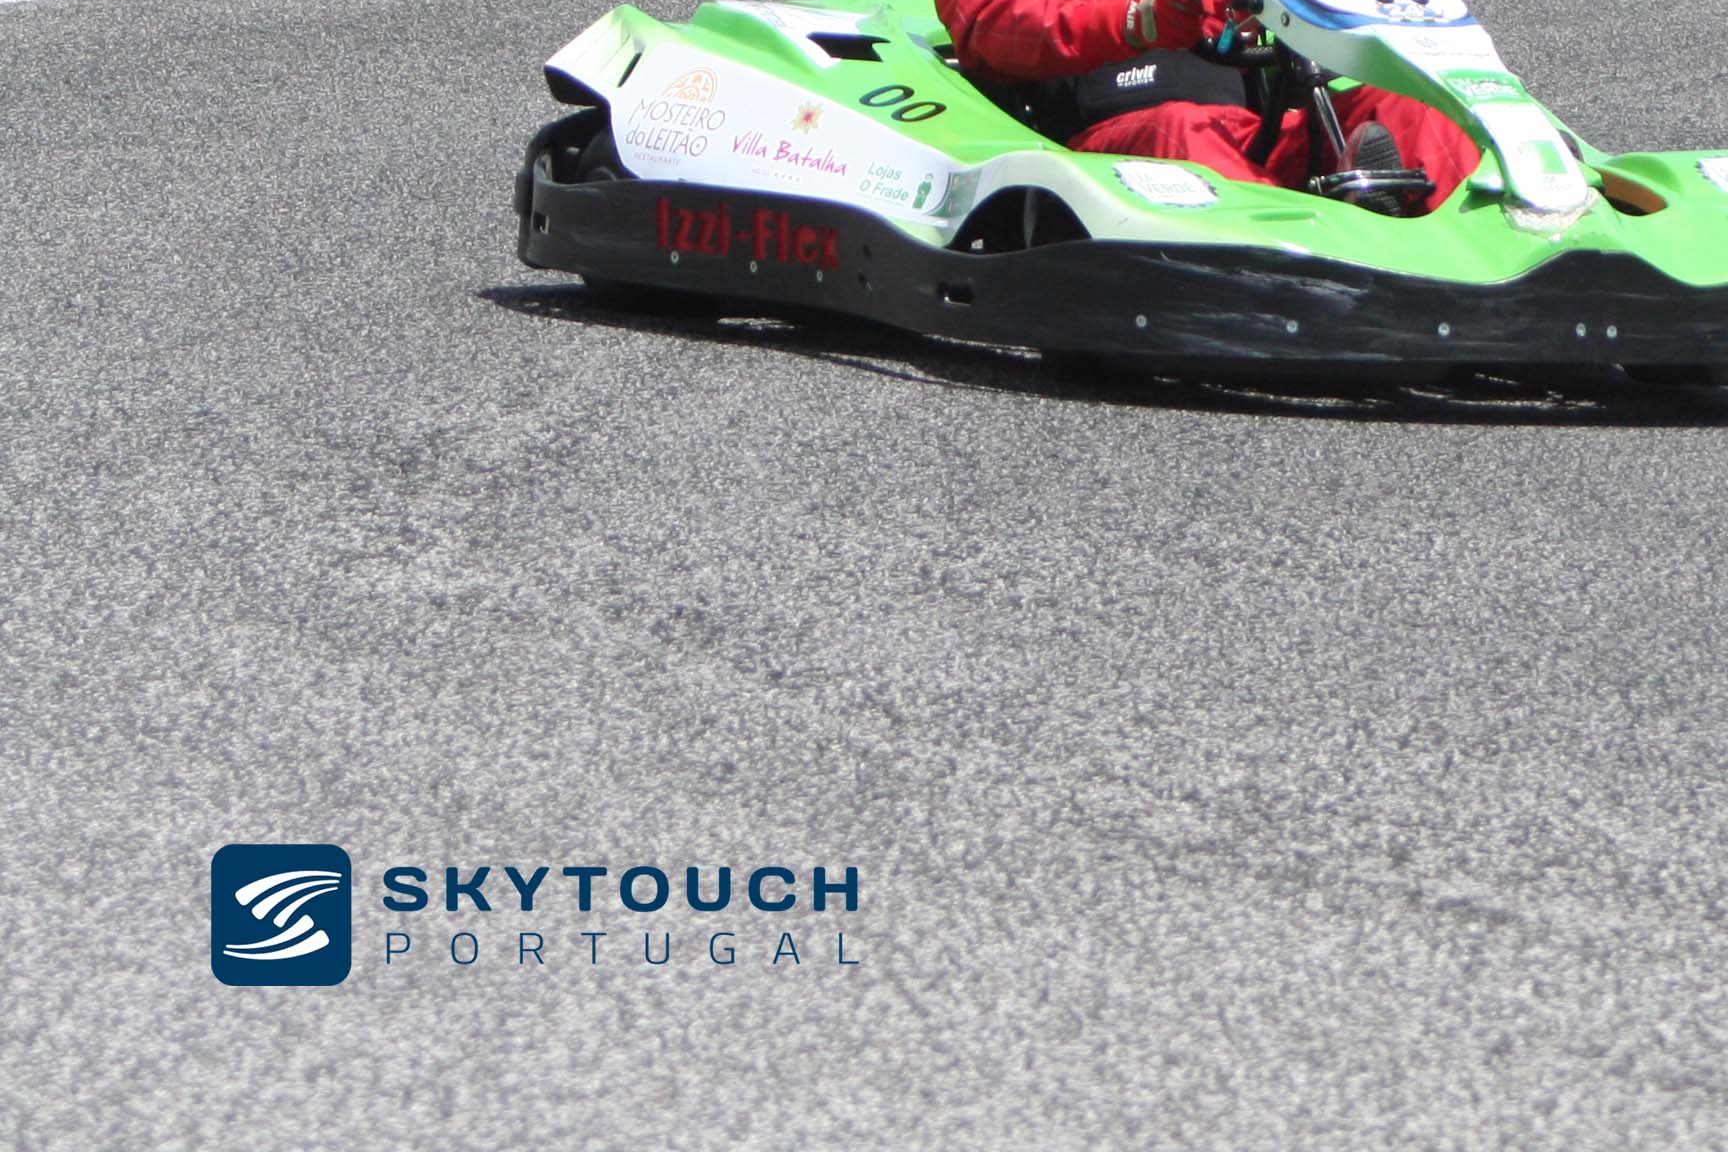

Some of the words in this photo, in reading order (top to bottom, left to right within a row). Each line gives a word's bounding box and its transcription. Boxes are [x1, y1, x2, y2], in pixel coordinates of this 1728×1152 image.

[628, 98, 726, 131] MOSTEIRO
[858, 84, 948, 122] 00
[733, 129, 767, 158] Villa
[773, 139, 848, 176] Batalha
[867, 161, 903, 180] Lojas
[859, 179, 872, 192] O
[872, 182, 910, 201] Frade
